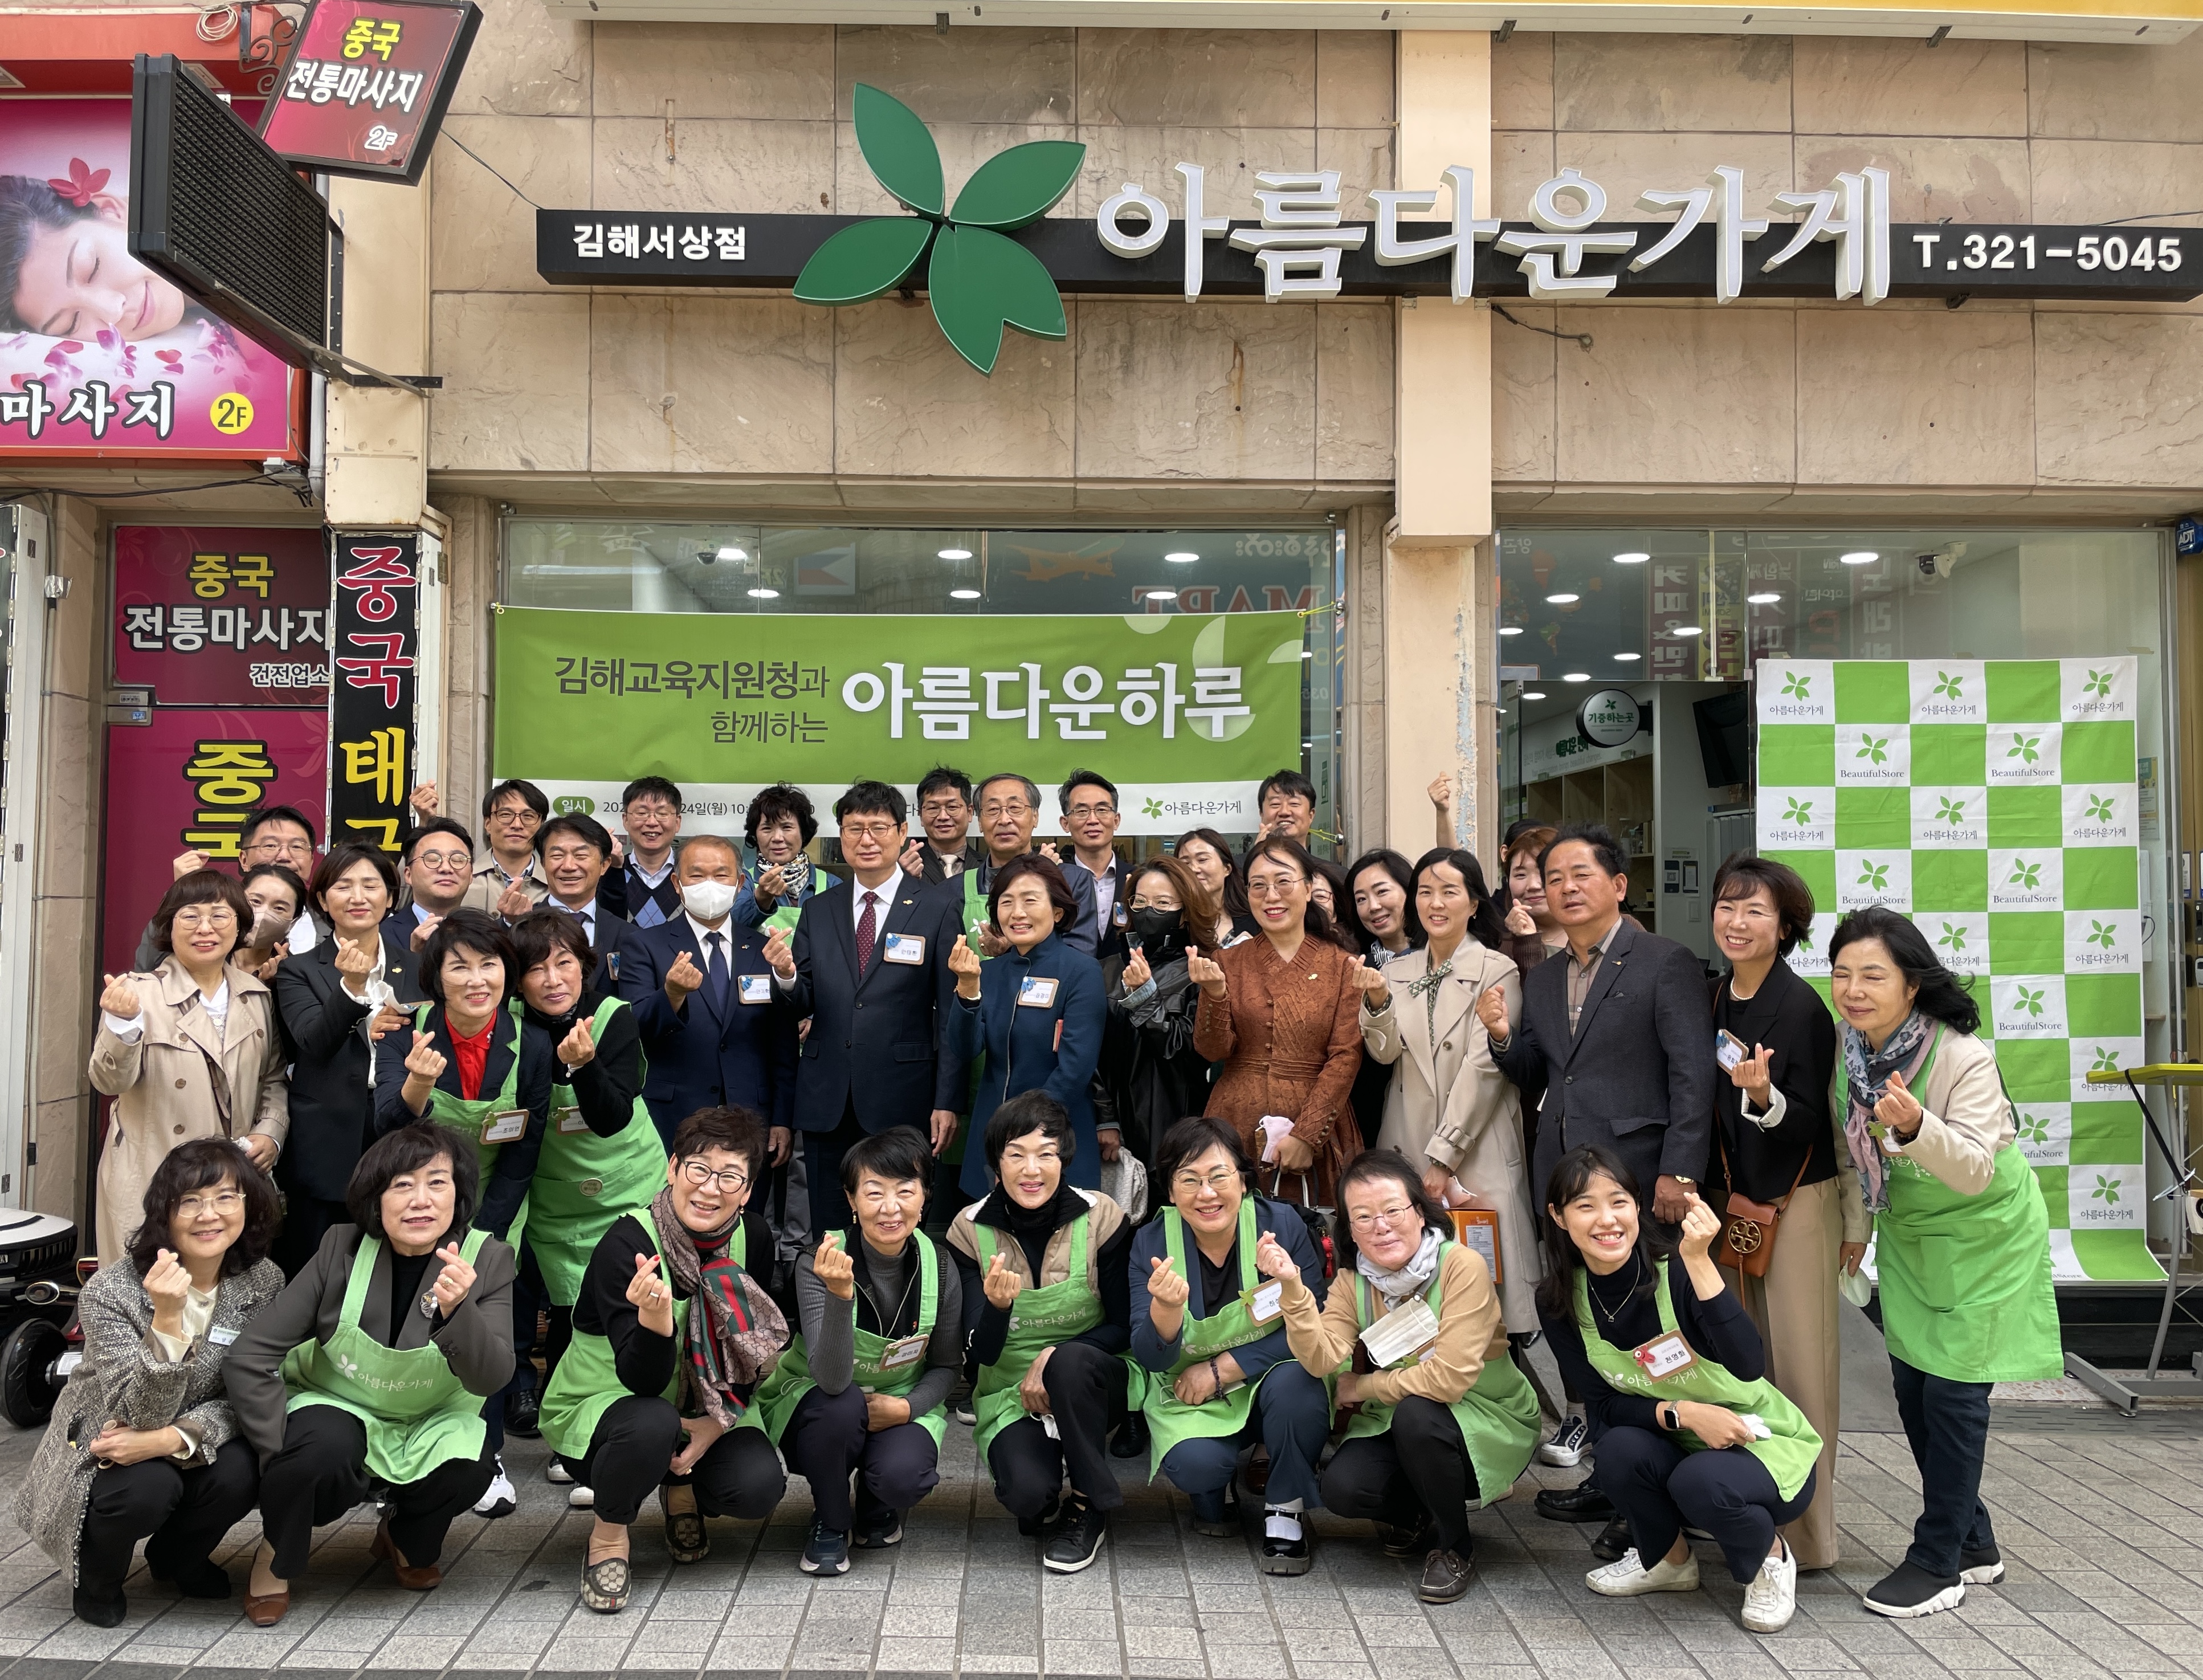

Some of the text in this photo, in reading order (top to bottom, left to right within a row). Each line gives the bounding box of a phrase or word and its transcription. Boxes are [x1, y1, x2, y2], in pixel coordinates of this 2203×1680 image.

[343, 19, 401, 61] 중국
[287, 60, 424, 113] 전통마사지
[364, 125, 398, 151] 2F
[1098, 161, 1890, 306] 아름다운가게
[572, 222, 747, 262] 김해서상점
[1912, 234, 2182, 272] T.321-5045
[0, 382, 173, 439] 마사지
[217, 399, 247, 428] 2F
[2178, 529, 2195, 546] ADT
[189, 554, 275, 598] 중국
[124, 606, 331, 651] 전통마사지
[336, 546, 417, 709] 중국
[250, 663, 330, 688] 건전업소
[554, 656, 1251, 740] 김해교육지원청과 아름다운하루
[1769, 704, 1824, 716] 아름다운가게
[1921, 704, 1976, 716] 아름다운가게
[2072, 700, 2124, 713] 아름다운가게
[1588, 712, 1634, 723] 기증하는곳
[710, 711, 829, 743] 함께하는
[1840, 769, 1904, 778] BeautifulStore
[1991, 768, 2055, 777] BeautifulStore
[561, 800, 587, 813] 일시
[603, 802, 626, 813] 202
[731, 804, 750, 814] 10:
[1164, 800, 1242, 815] 아름다운가게
[1769, 830, 1824, 842] 아름다운가게
[1923, 829, 1978, 841] 아름다운가게
[2073, 827, 2127, 838] 아름다운가게
[1842, 895, 1906, 905] BeautifulStore
[1993, 894, 2057, 904] BeautifulStore
[1785, 956, 1829, 968] 름다운가게
[1939, 955, 1980, 967] 름다운가게
[2075, 953, 2129, 965] 아름다운가게
[1998, 1021, 2062, 1031] BeautifulStore
[2024, 1150, 2064, 1159] tifulStore
[2080, 1209, 2133, 1221] 아름다운가게
[1022, 1307, 1086, 1328] 아름다운가게
[1198, 1328, 1266, 1353] 아름다운가게
[358, 1373, 434, 1392] 아름다운가게
[1627, 1368, 1698, 1388] 아름가게
